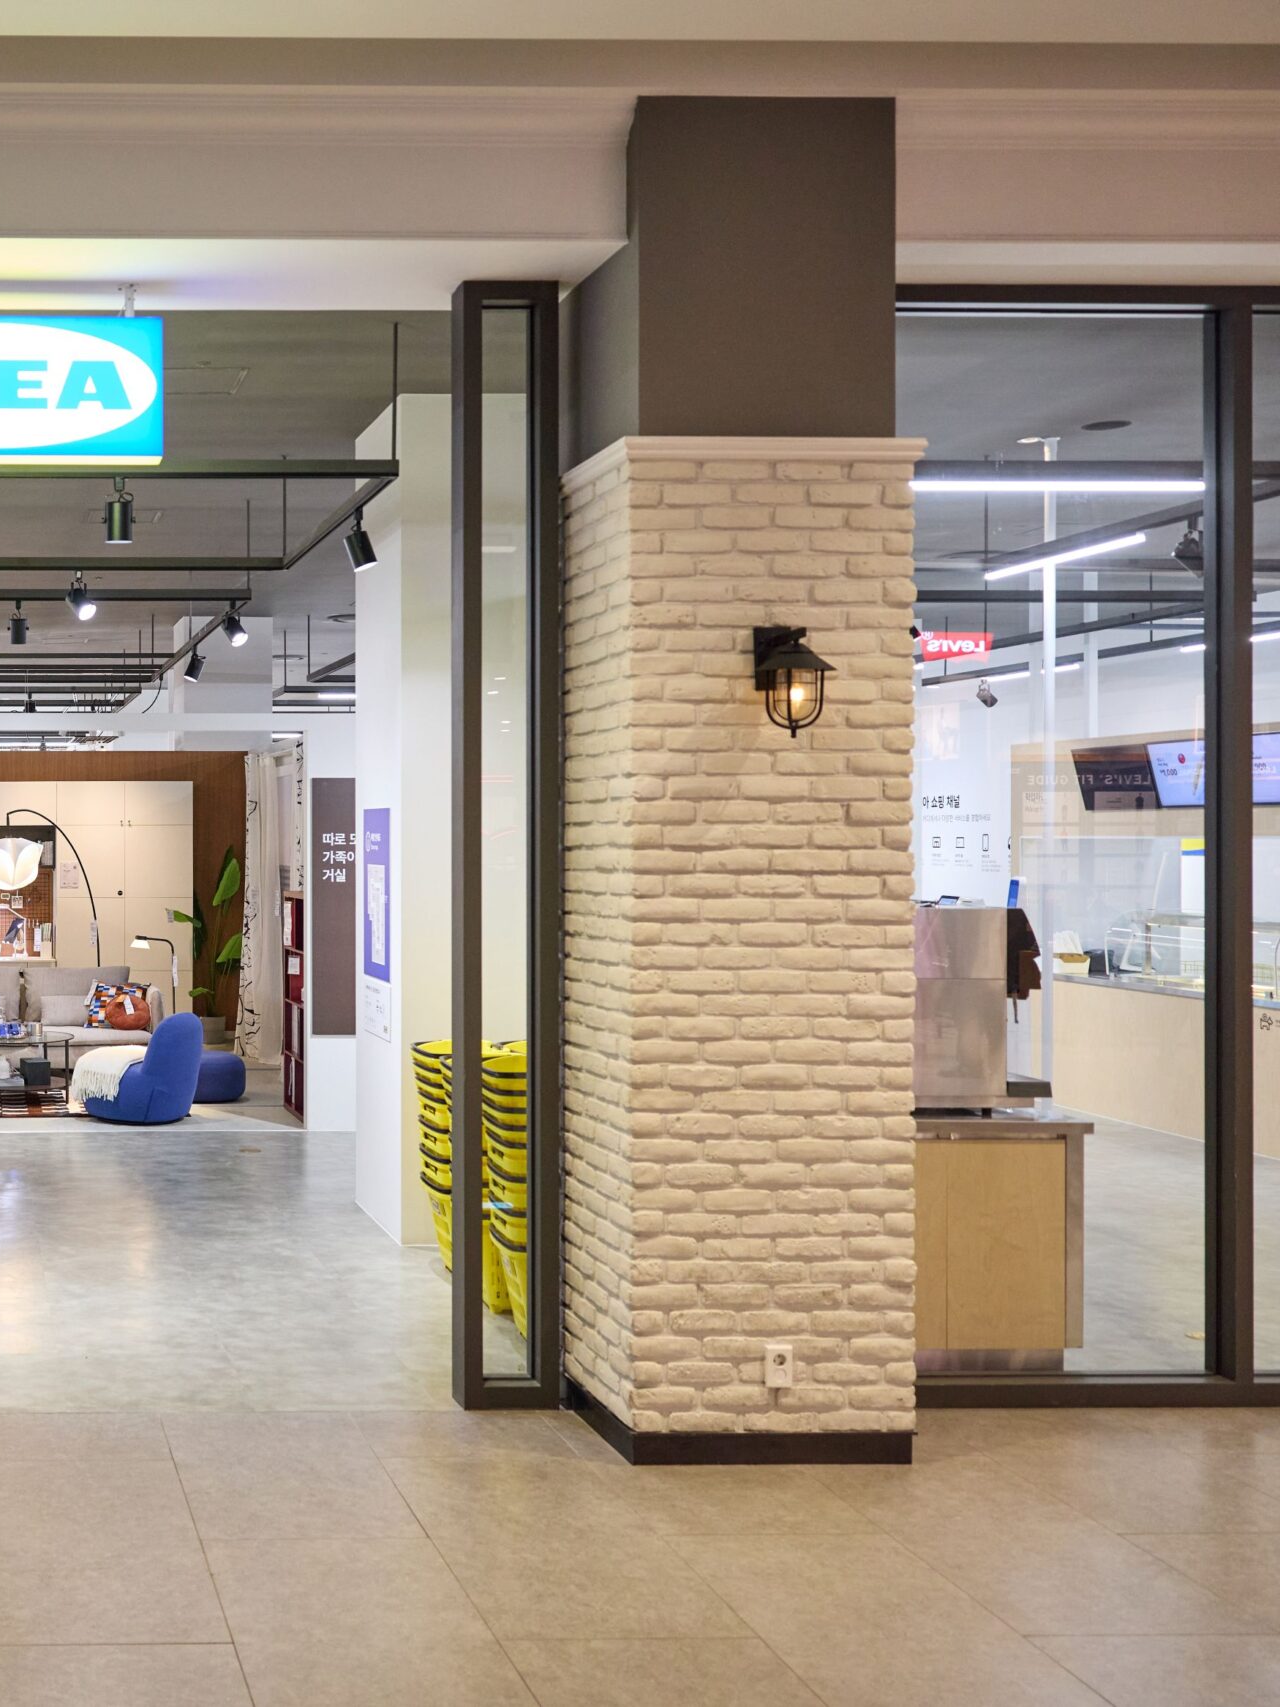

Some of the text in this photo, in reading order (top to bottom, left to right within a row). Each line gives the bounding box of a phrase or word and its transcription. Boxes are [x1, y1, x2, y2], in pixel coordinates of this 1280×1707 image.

[931, 795, 944, 809] 쇼핑
[946, 795, 960, 809] 채널
[322, 832, 346, 846] 따로
[322, 868, 346, 883] 거실
